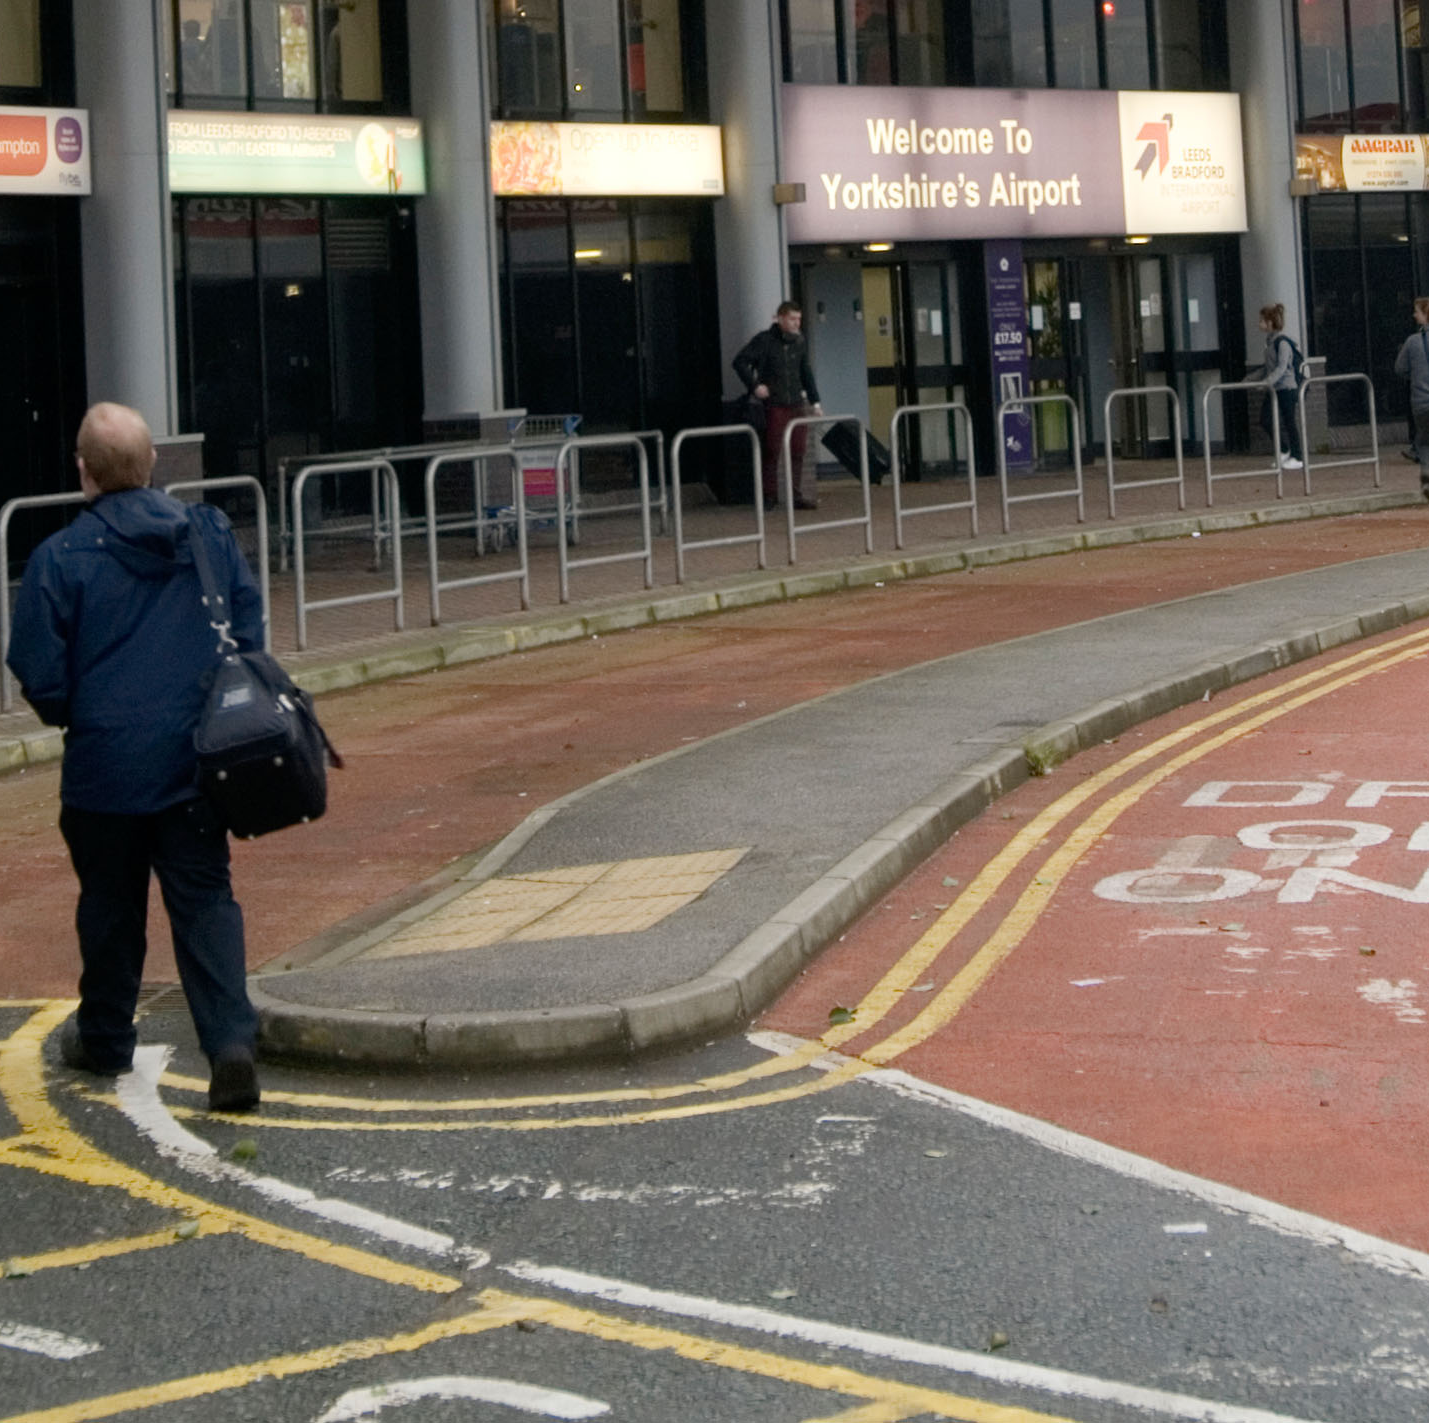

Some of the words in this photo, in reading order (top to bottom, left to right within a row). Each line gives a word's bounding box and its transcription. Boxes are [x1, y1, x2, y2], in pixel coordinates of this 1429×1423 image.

[169, 122, 199, 137] FROM
[202, 123, 231, 138] LEEDS
[232, 124, 287, 140] BRADFORD
[288, 125, 302, 140] TO
[304, 126, 353, 142] ABERDEEN
[867, 119, 994, 155] Welcome
[1000, 119, 1033, 155] To
[177, 140, 217, 155] BRISTOL
[218, 141, 245, 155] WITH
[246, 142, 290, 157] EASTERN
[1183, 148, 1212, 162] LEEDS
[1171, 165, 1225, 180] BRADFORD
[989, 172, 1082, 215] Airport
[1181, 199, 1220, 214] AIRPORT
[995, 331, 1023, 345] £17.50
